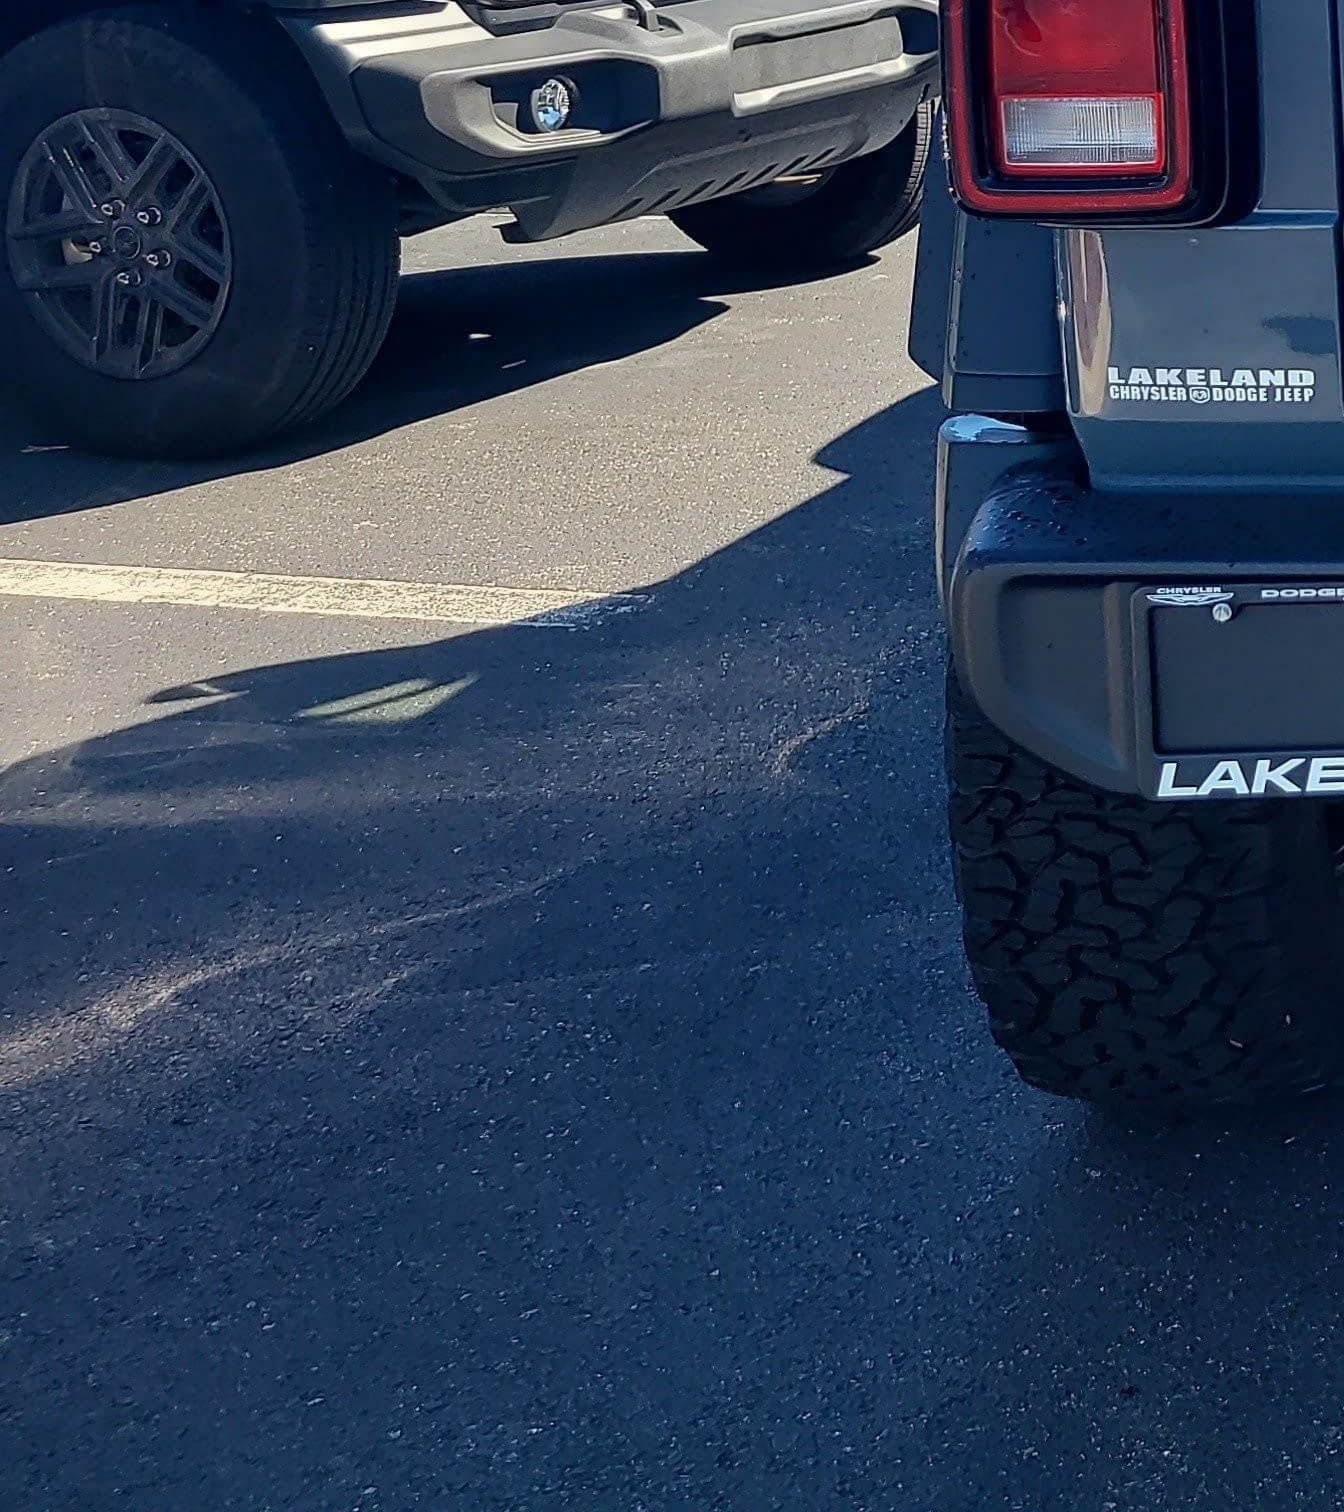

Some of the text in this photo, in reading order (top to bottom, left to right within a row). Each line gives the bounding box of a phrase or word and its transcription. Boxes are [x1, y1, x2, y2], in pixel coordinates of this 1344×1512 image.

[1107, 366, 1316, 387] LAKELAND
[1109, 386, 1314, 403] CHRYSLER DODGE JEEP
[1156, 585, 1222, 595] CHRYSLER
